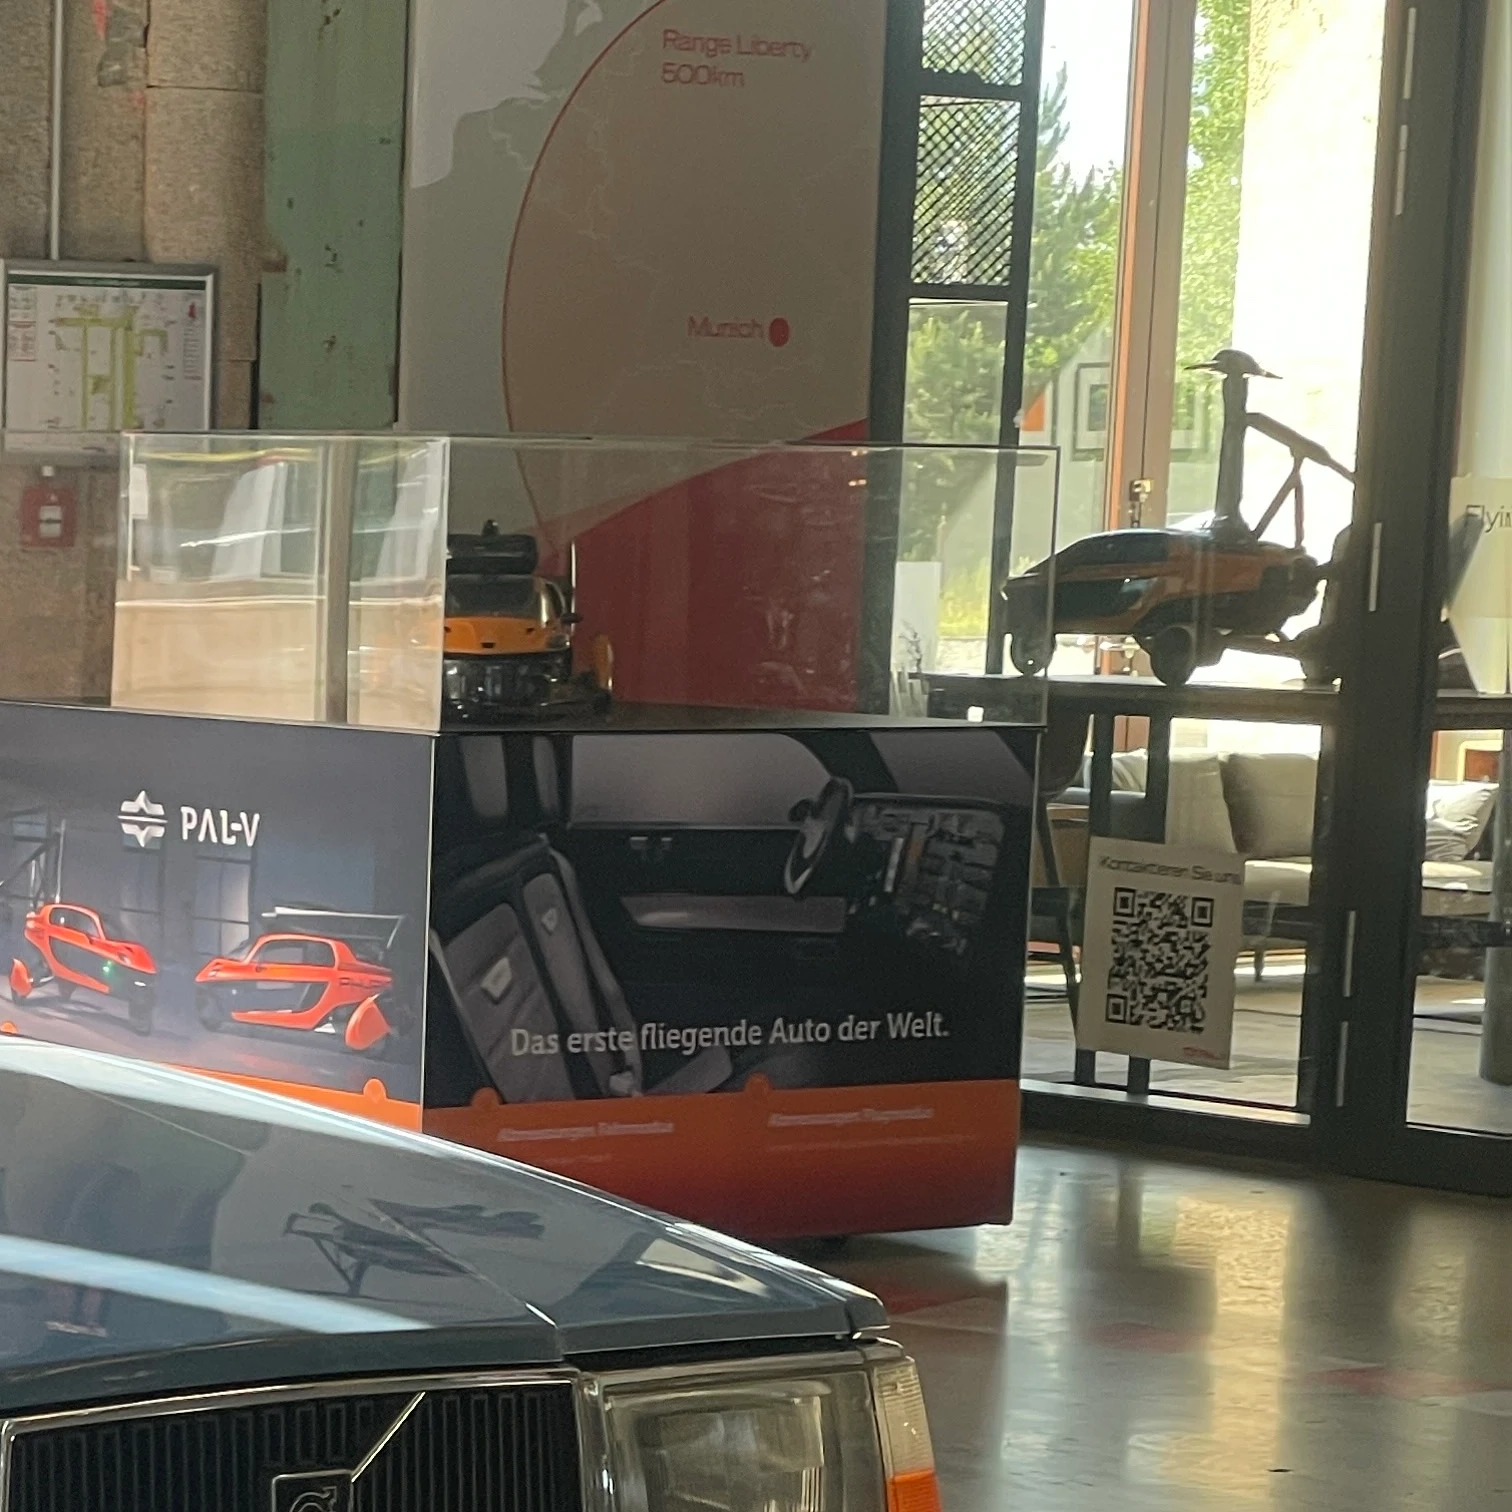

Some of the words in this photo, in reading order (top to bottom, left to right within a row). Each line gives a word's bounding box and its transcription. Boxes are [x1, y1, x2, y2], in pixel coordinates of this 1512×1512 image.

[662, 28, 732, 58] Range
[662, 62, 745, 87] 500km
[180, 806, 260, 847] PAL-V
[511, 1028, 560, 1056] Das
[567, 1027, 634, 1054] erste
[640, 1019, 762, 1056] fliegende
[769, 1017, 832, 1044] Auto
[838, 1014, 881, 1042] der
[887, 1010, 951, 1039] Welt.
